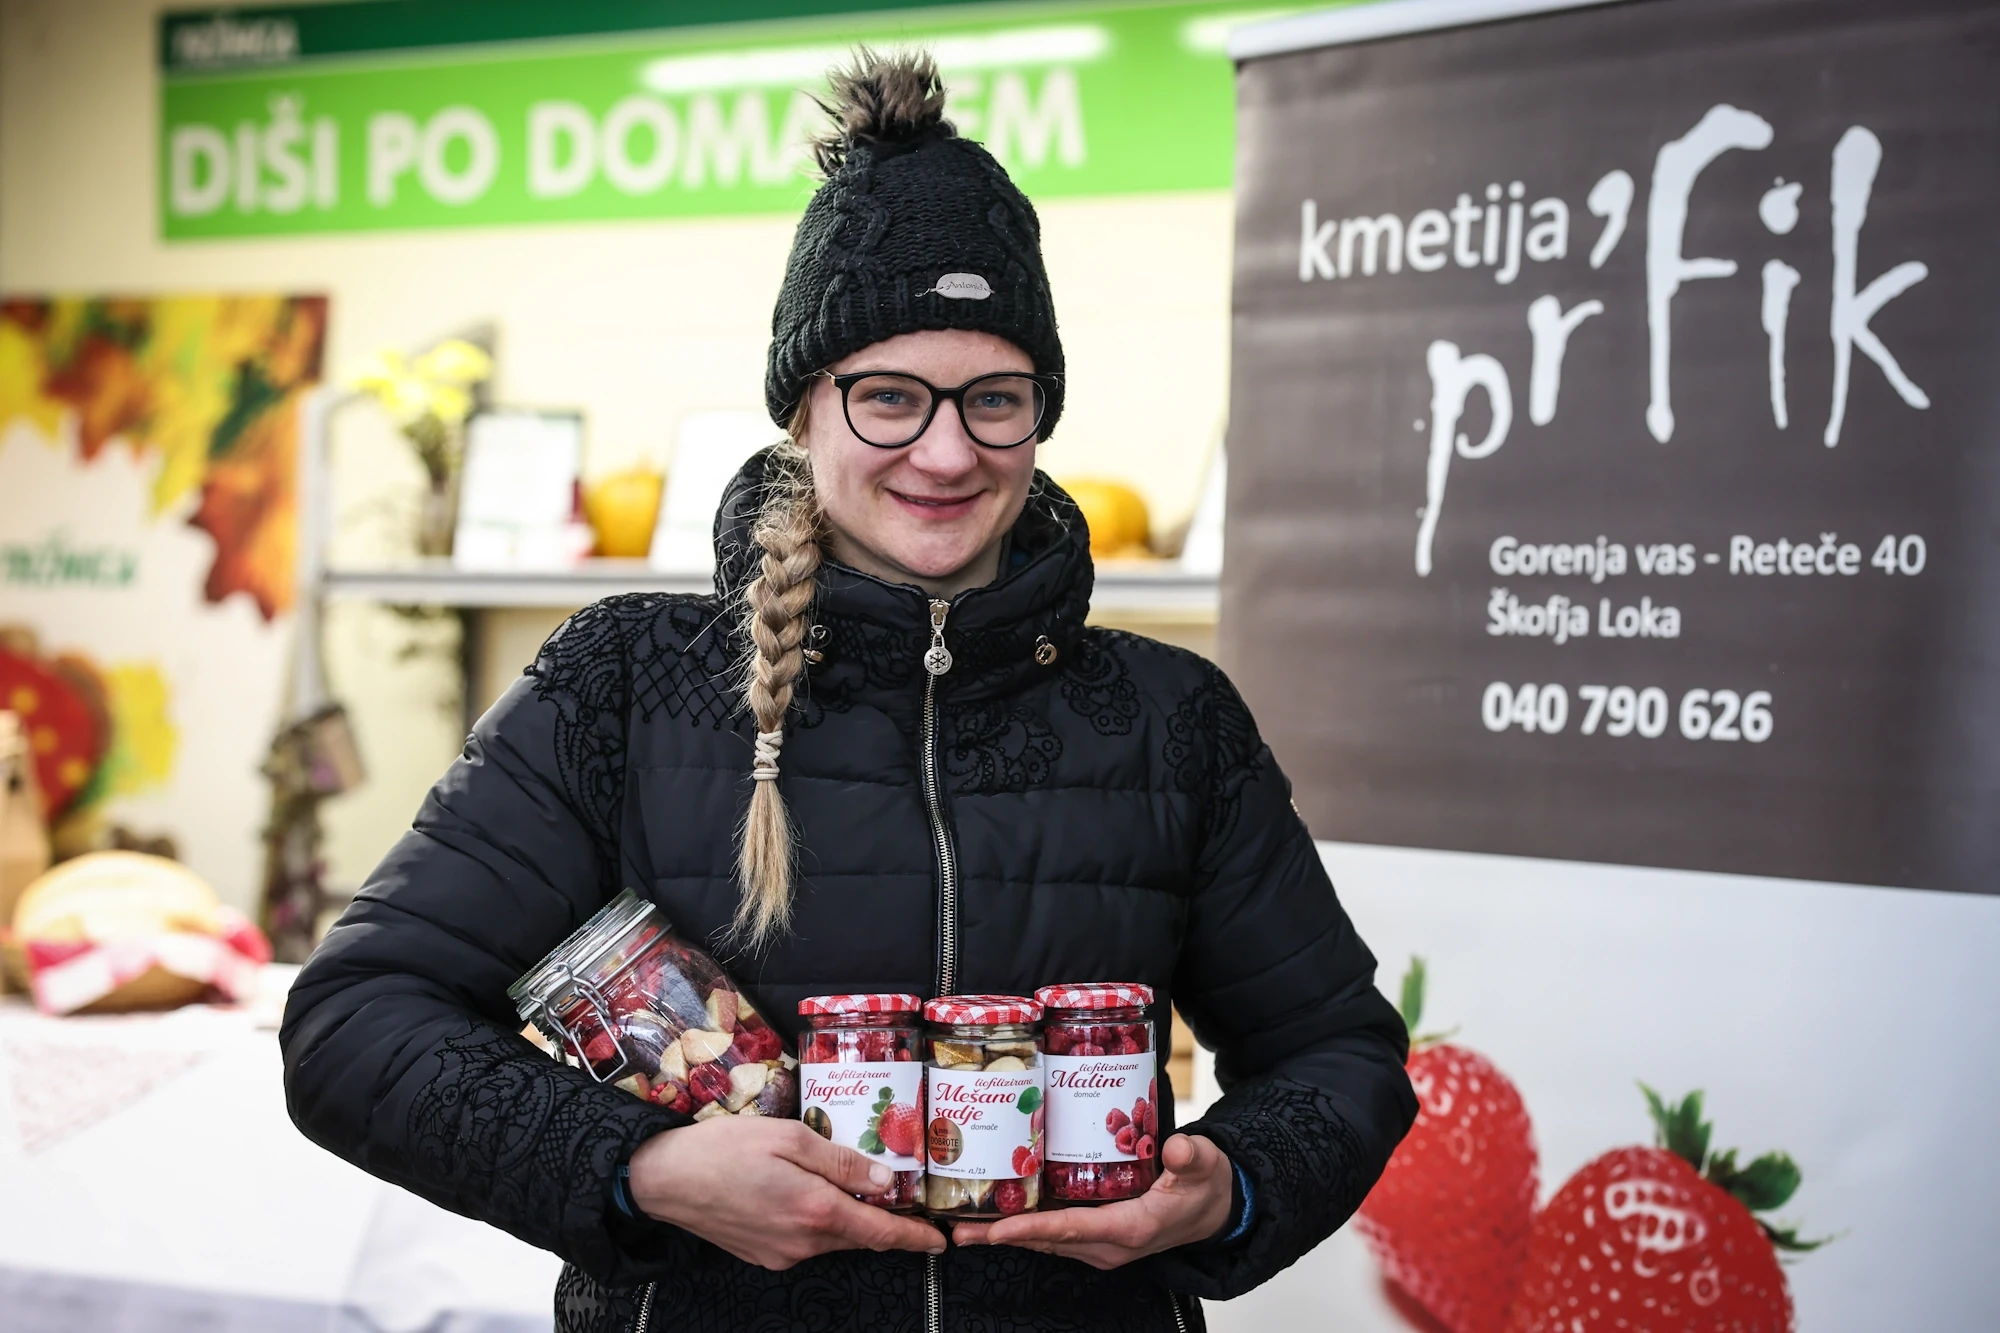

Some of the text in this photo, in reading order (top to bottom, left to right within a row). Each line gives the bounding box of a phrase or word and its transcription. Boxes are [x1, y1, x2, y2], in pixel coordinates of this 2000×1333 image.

[170, 96, 340, 216] DIŠI
[367, 107, 500, 206] PO
[1300, 181, 1570, 283] kmetija
[1490, 537, 1627, 583] Gorenja
[1637, 543, 1696, 575] vas
[1729, 532, 1861, 576] Reteče
[1872, 535, 1927, 576] 40
[1487, 588, 1682, 645] Škofja Loka
[1482, 683, 1775, 742] 040 790 626
[828, 1069, 891, 1082] liofilizirane
[1050, 1069, 1126, 1089] Maline
[1079, 1062, 1139, 1075] liofilizirane
[804, 1078, 870, 1103] Jagode
[935, 1082, 1017, 1104] Mešano
[974, 1077, 1034, 1090] liofilizirano
[934, 1104, 984, 1126] sadje
[970, 1123, 999, 1131] domače
[930, 1136, 959, 1147] DOBROTE
